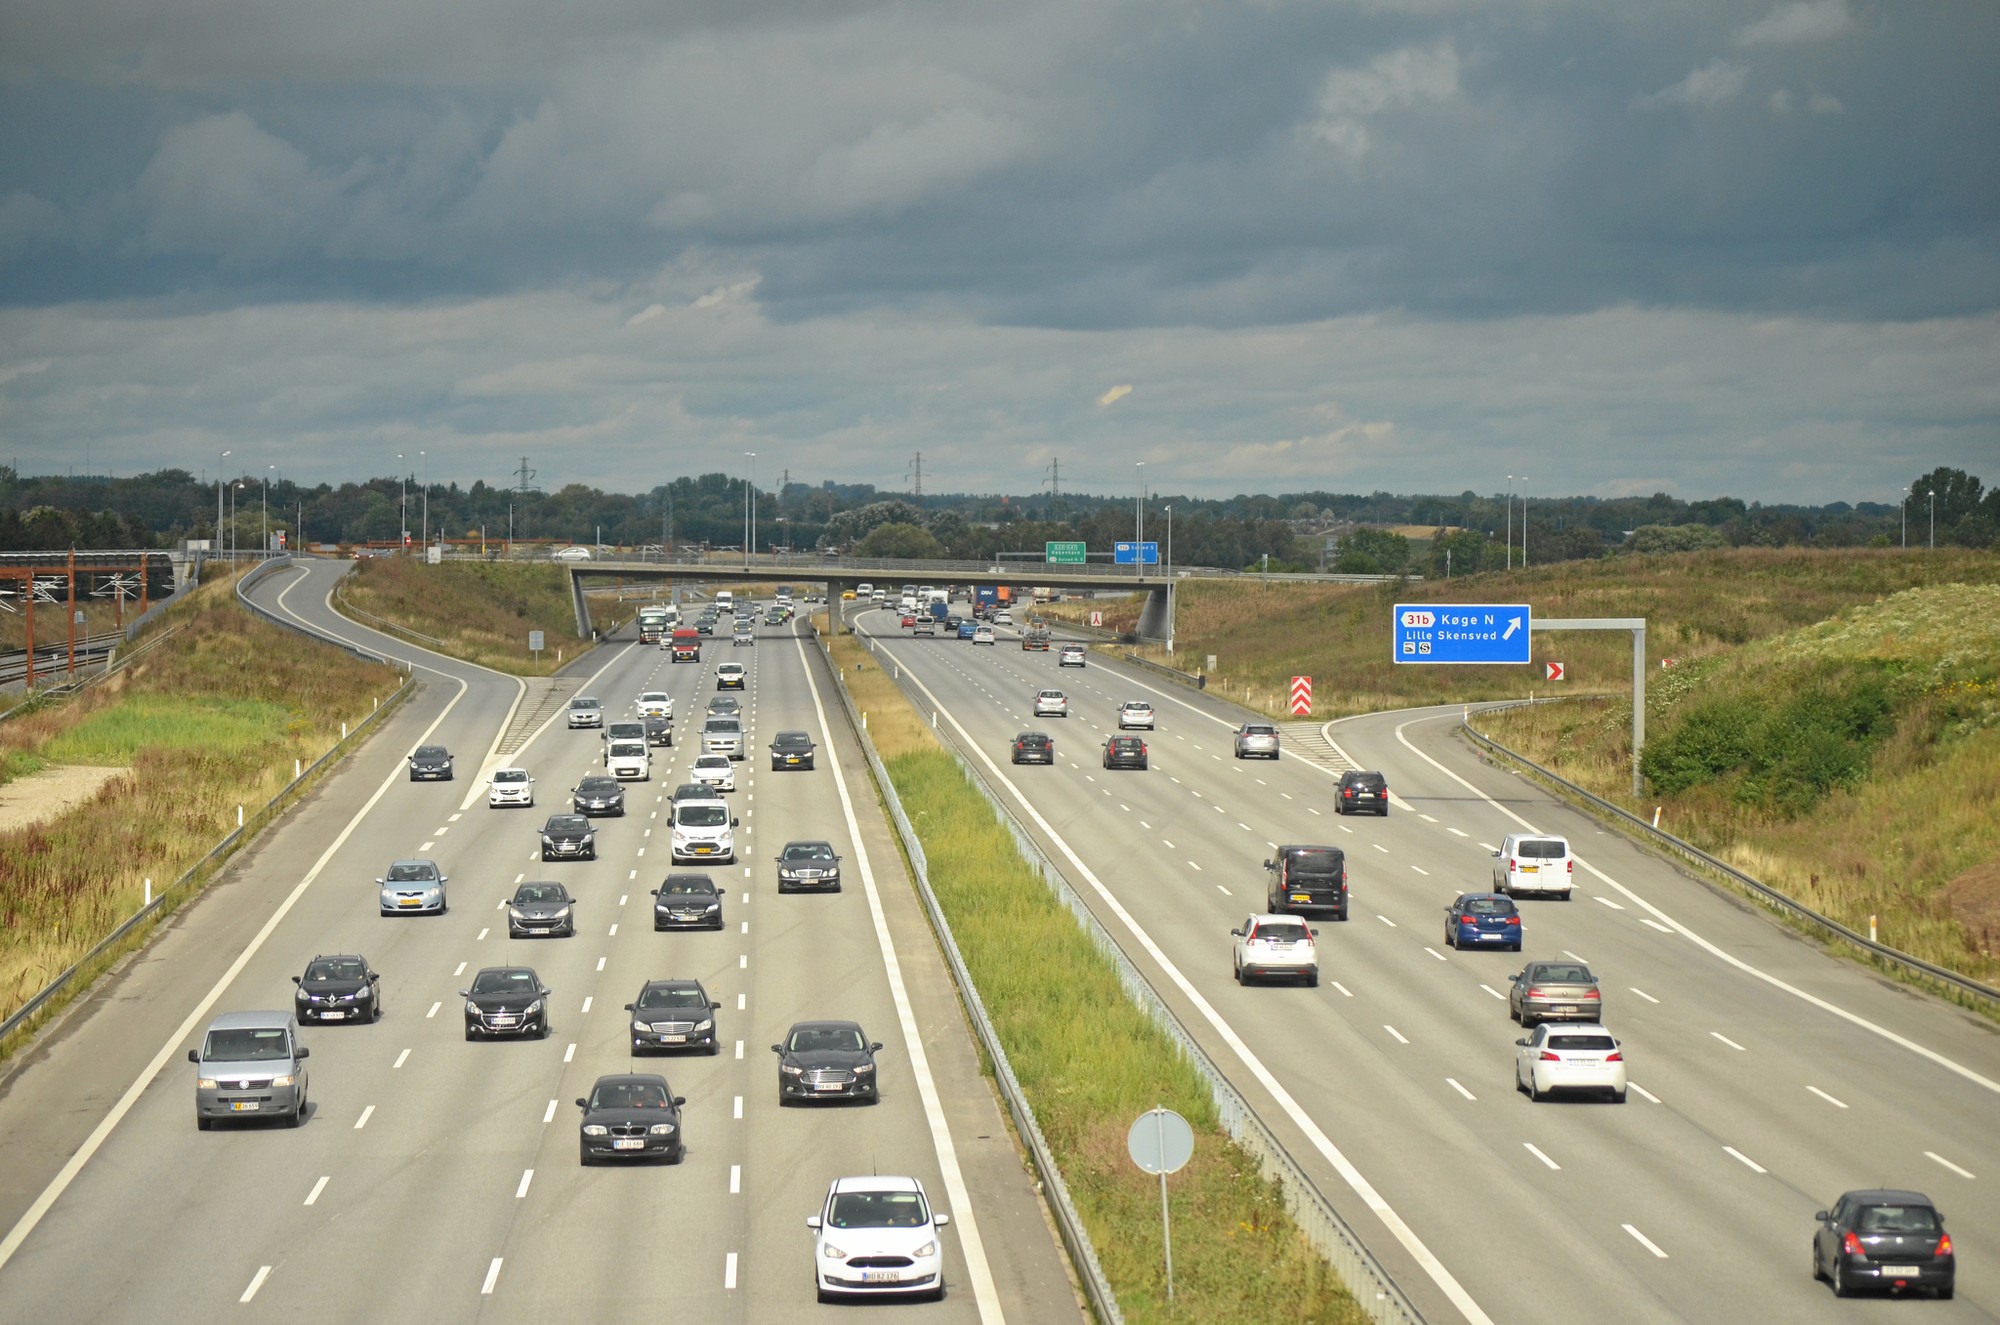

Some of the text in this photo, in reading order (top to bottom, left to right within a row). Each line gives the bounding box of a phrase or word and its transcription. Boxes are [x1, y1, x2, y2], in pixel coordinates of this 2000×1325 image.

[1407, 614, 1429, 624] 31b
[1441, 614, 1494, 627] Køge N
[1406, 630, 1497, 640] Lille Skensved
